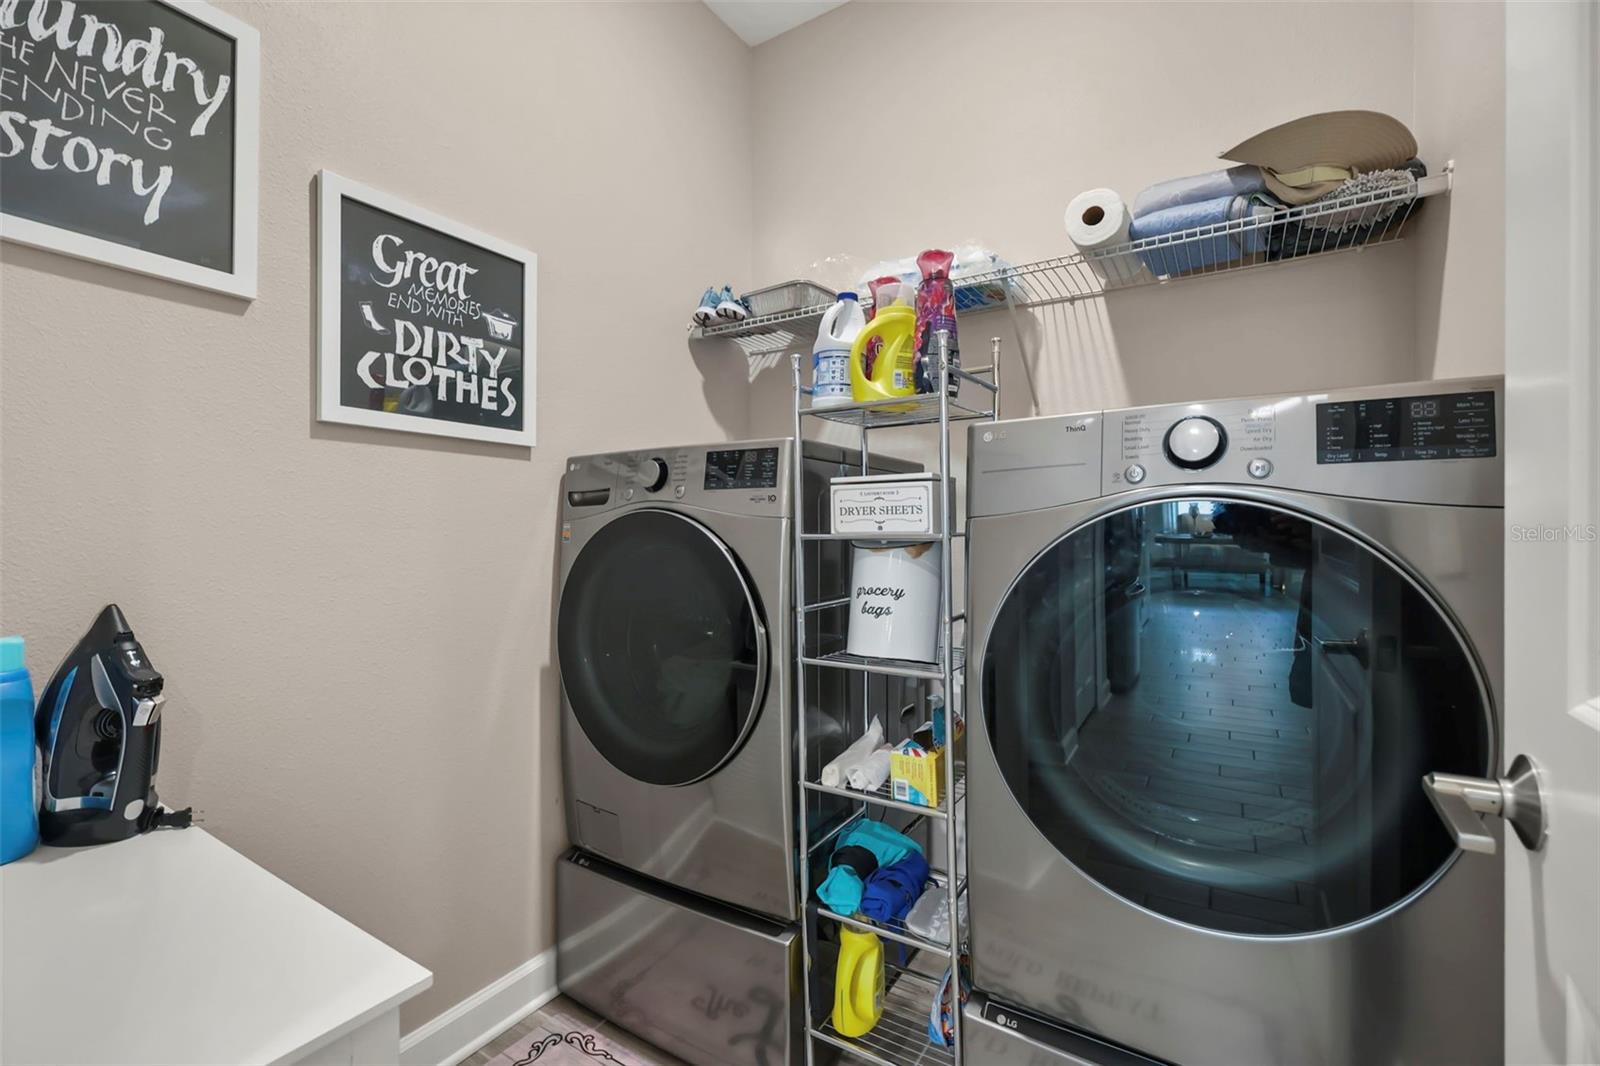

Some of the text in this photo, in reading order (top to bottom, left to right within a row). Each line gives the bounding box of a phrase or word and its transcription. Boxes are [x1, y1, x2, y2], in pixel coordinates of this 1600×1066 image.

[44, 51, 176, 124] NEVER
[0, 67, 172, 150] ENDING
[370, 234, 479, 300] Great
[387, 292, 464, 328] END WITH
[407, 283, 481, 320] MEMORIES
[394, 318, 507, 379] DIRTY
[356, 351, 517, 417] CLOTHES
[1065, 424, 1086, 433] ThinQ
[840, 504, 923, 517] DRYER SHEETS
[856, 584, 906, 600] grocery
[861, 600, 894, 618] bags
[1006, 1018, 1018, 1029] LG
